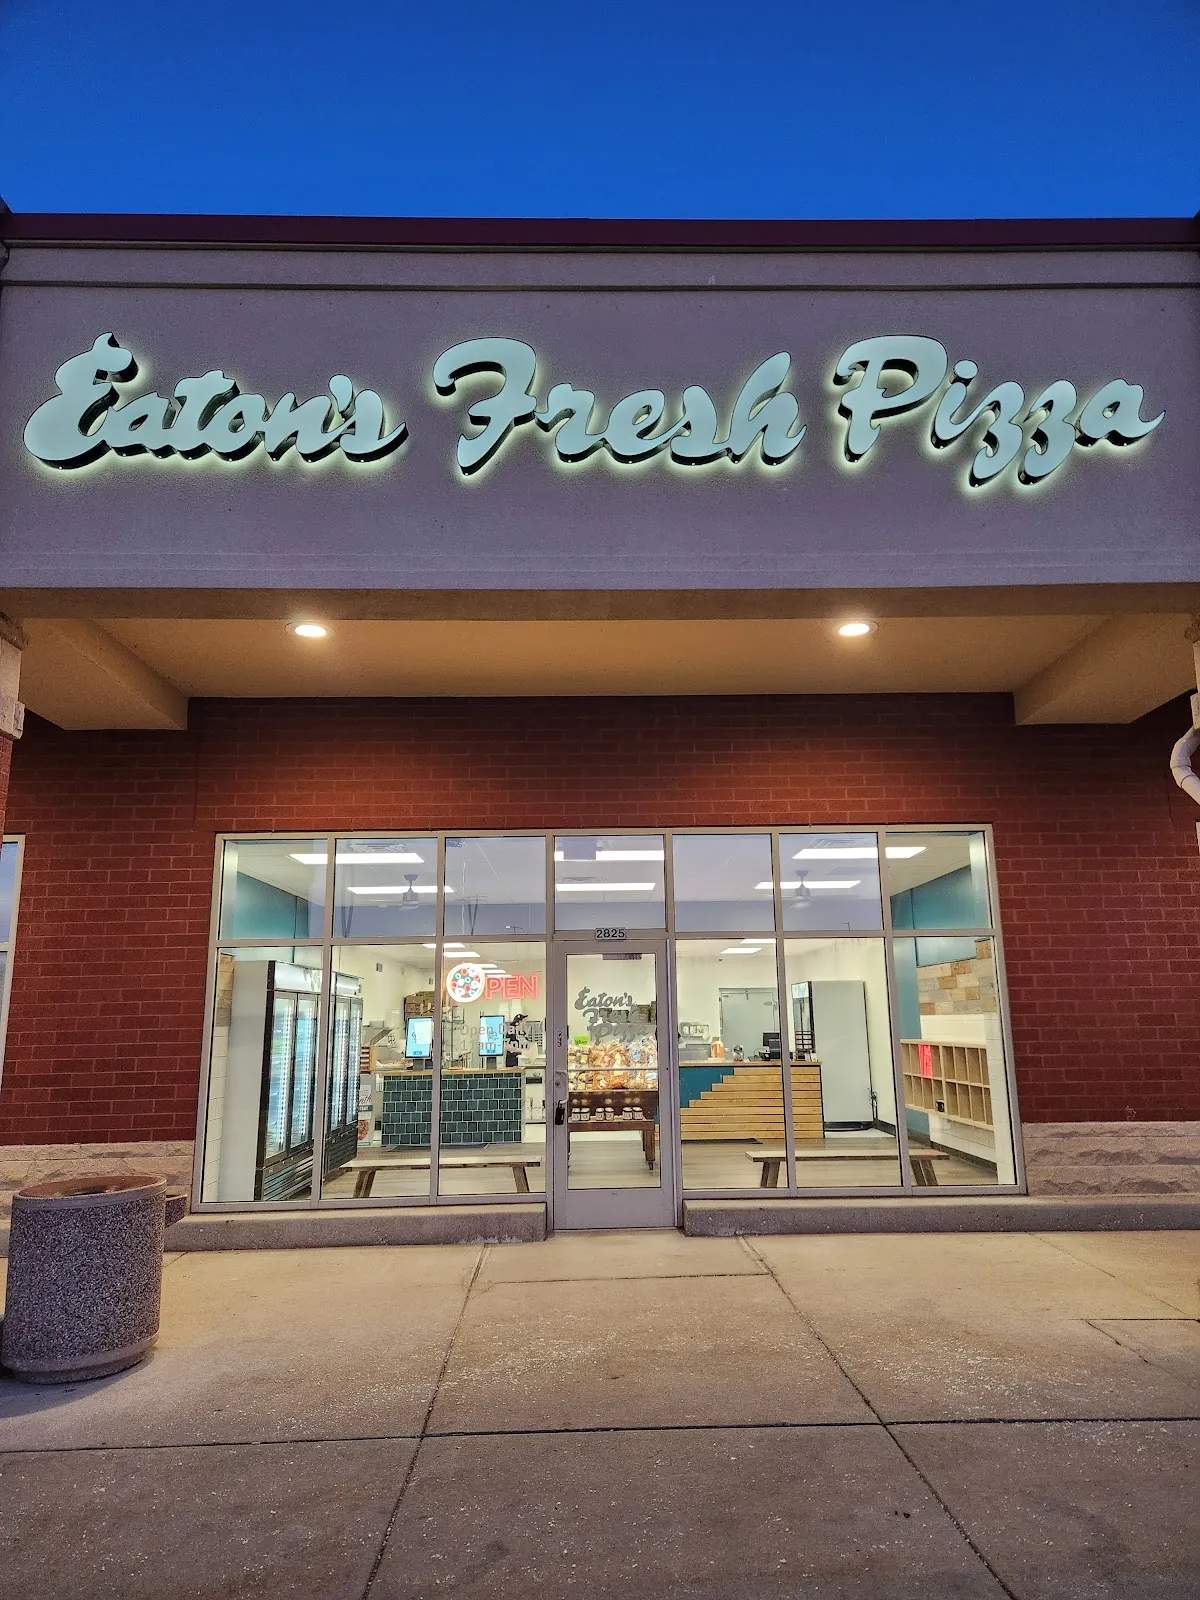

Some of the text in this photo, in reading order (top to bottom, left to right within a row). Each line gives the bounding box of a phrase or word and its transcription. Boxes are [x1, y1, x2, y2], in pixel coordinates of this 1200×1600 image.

[23, 332, 1165, 487] Eaton's Fresh Pizza
[596, 928, 625, 939] 2825
[574, 986, 633, 1010] Eaton's
